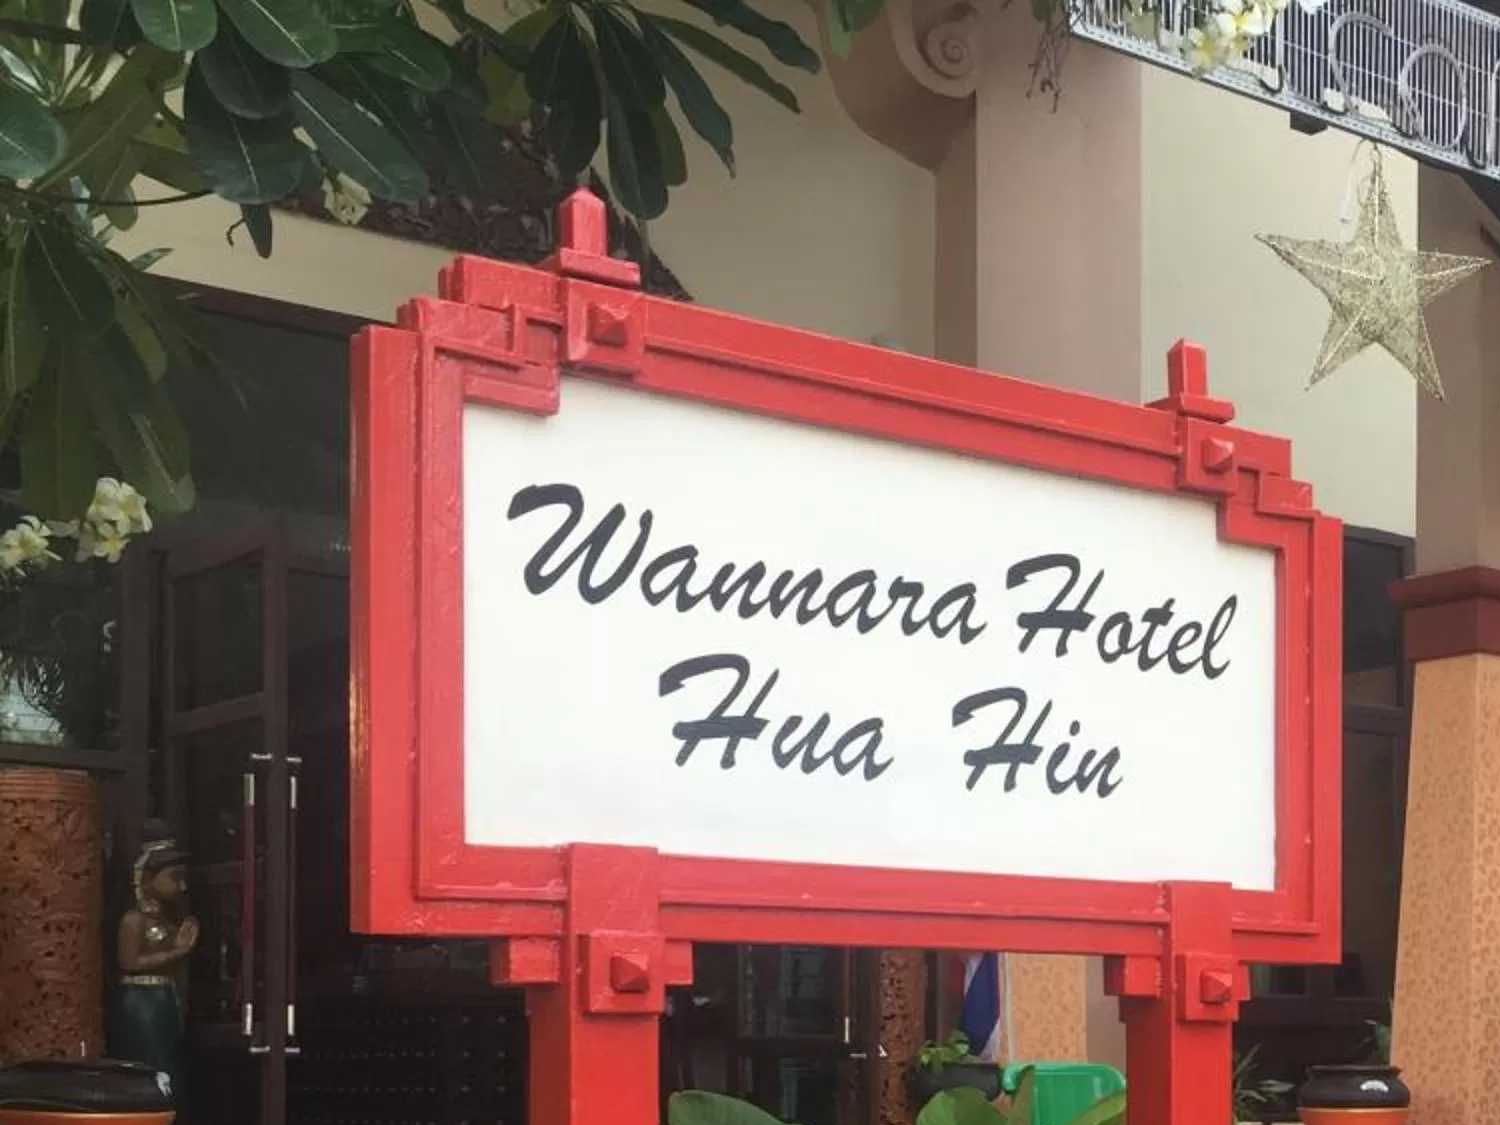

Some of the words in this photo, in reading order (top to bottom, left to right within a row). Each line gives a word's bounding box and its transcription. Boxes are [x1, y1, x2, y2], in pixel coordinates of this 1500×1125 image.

[508, 484, 987, 645] Wannara
[1006, 553, 1238, 680] Hotel
[659, 653, 894, 781] Hua
[952, 687, 1122, 798] Hin
